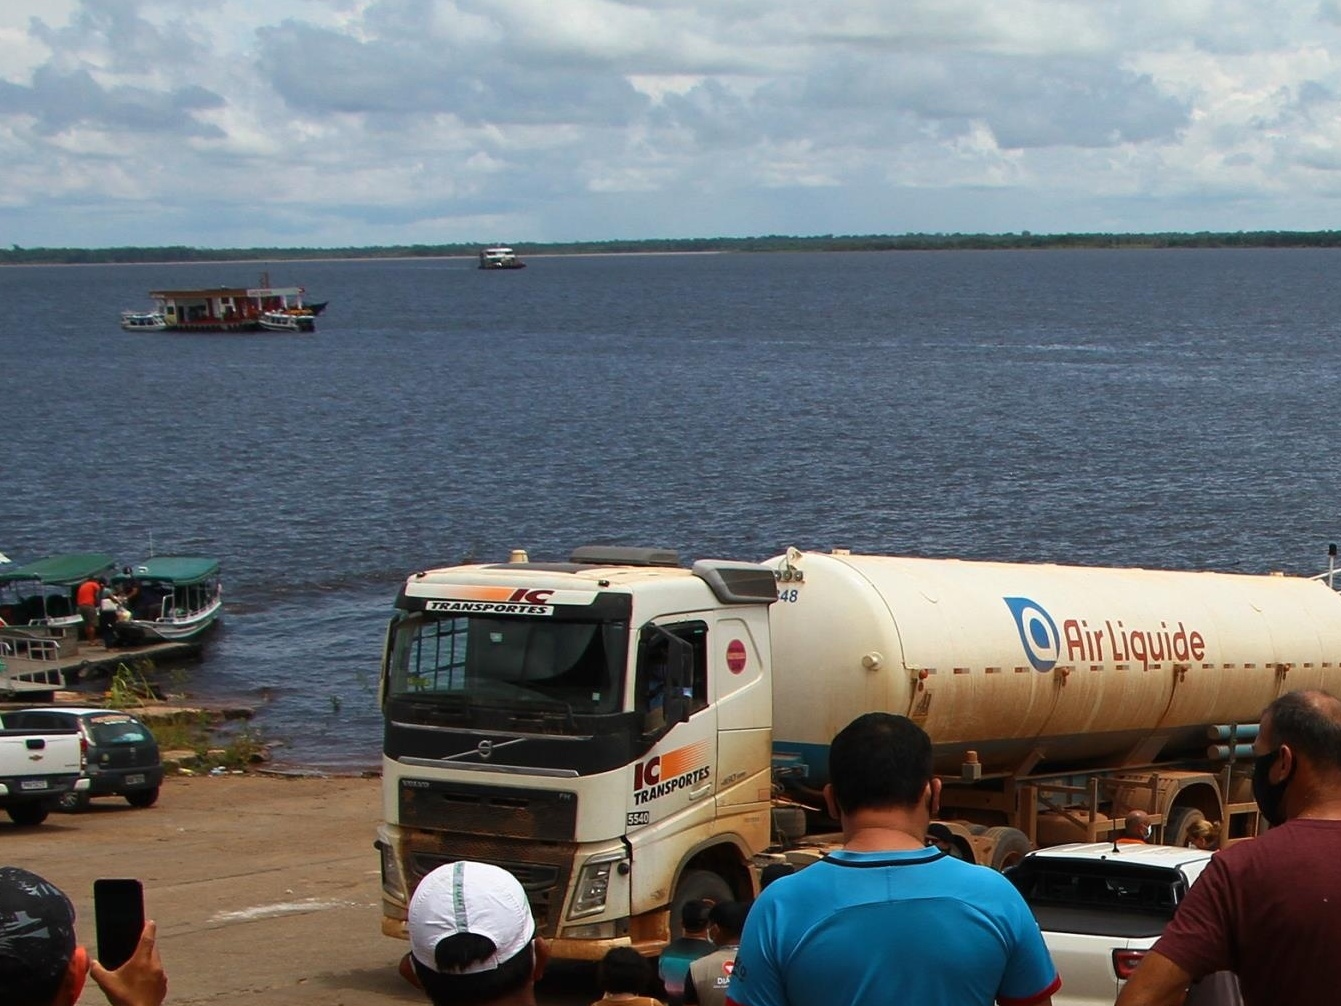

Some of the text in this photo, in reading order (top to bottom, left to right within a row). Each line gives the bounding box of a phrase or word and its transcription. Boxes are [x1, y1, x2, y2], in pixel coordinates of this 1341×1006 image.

[431, 602, 547, 614] TRANSPORTES
[508, 588, 555, 605] IC
[1063, 619, 1205, 672] Air Liquide
[634, 756, 661, 791] IC
[634, 765, 710, 806] TRANSPORTES
[628, 812, 649, 825] 5540
